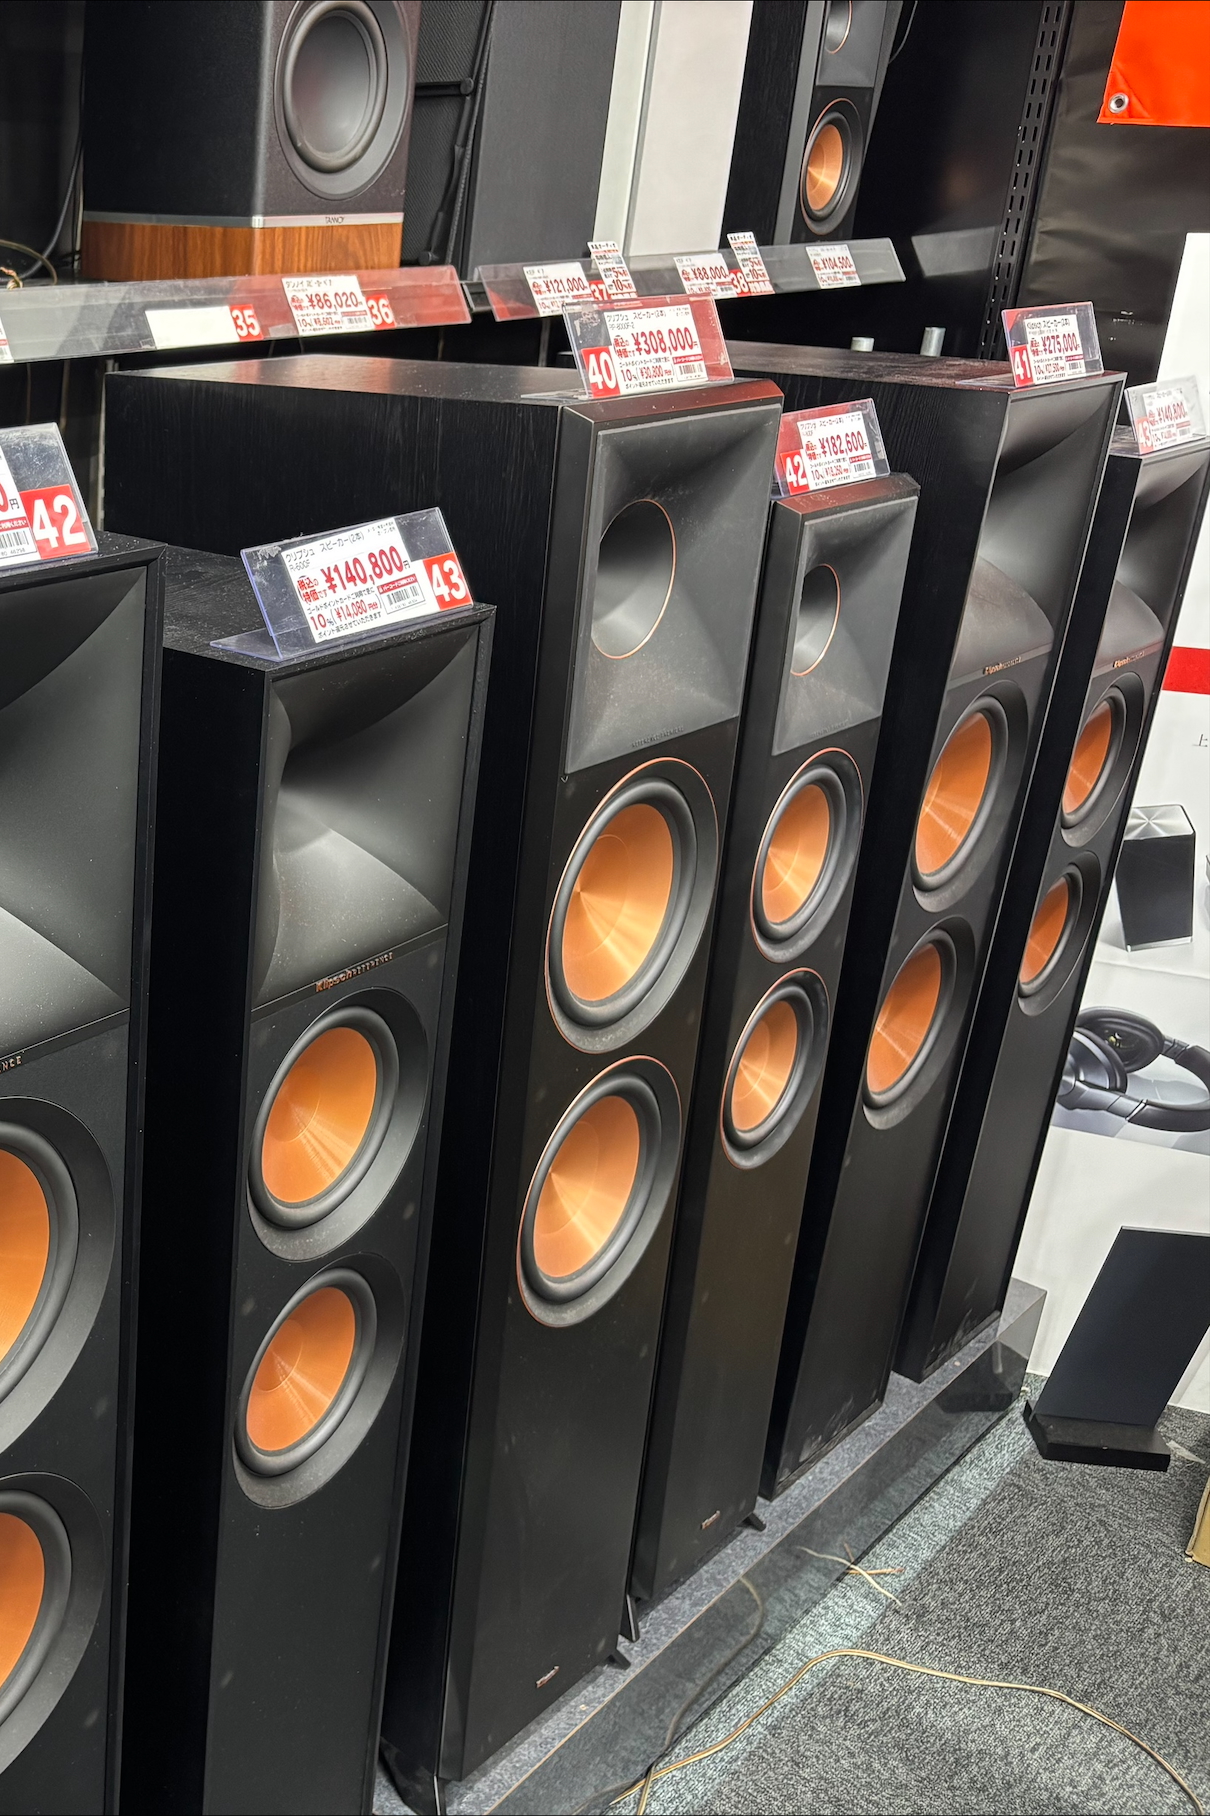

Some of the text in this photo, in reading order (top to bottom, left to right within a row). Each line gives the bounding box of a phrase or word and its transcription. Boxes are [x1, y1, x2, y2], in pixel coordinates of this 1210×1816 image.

[591, 283, 608, 301] 37
[730, 273, 749, 293] 38
[231, 308, 260, 337] 35
[367, 298, 394, 326] 36
[589, 351, 617, 390] 40
[1014, 349, 1031, 380] 41
[786, 454, 807, 488] 42
[33, 494, 87, 549] 42
[286, 549, 315, 563] クリプシュ
[431, 560, 467, 602] 43
[315, 969, 352, 993] Klipsch
